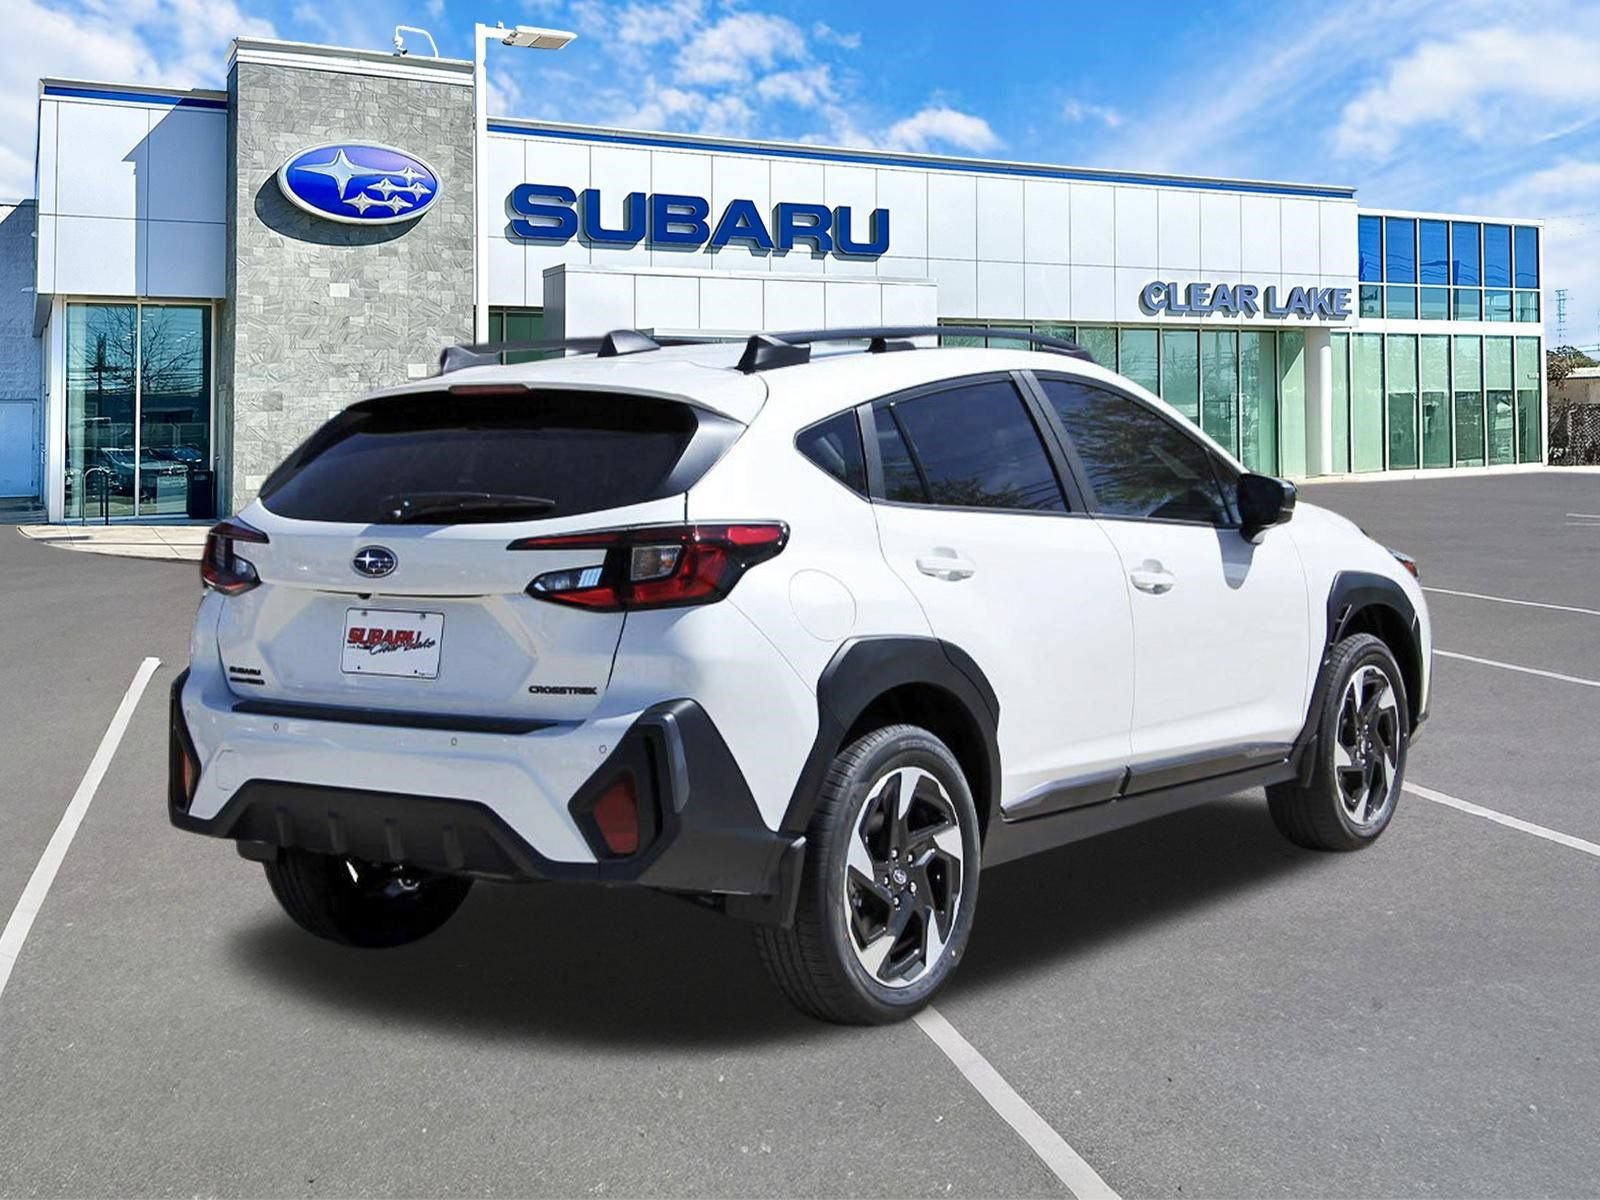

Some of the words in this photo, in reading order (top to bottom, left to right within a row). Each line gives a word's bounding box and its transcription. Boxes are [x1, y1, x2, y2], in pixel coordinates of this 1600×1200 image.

[506, 183, 889, 258] SUBARU
[1140, 281, 1260, 317] CLEAR
[1264, 286, 1352, 319] LAKE
[347, 627, 422, 645] SUBARU
[528, 685, 598, 695] CROSSTREK
